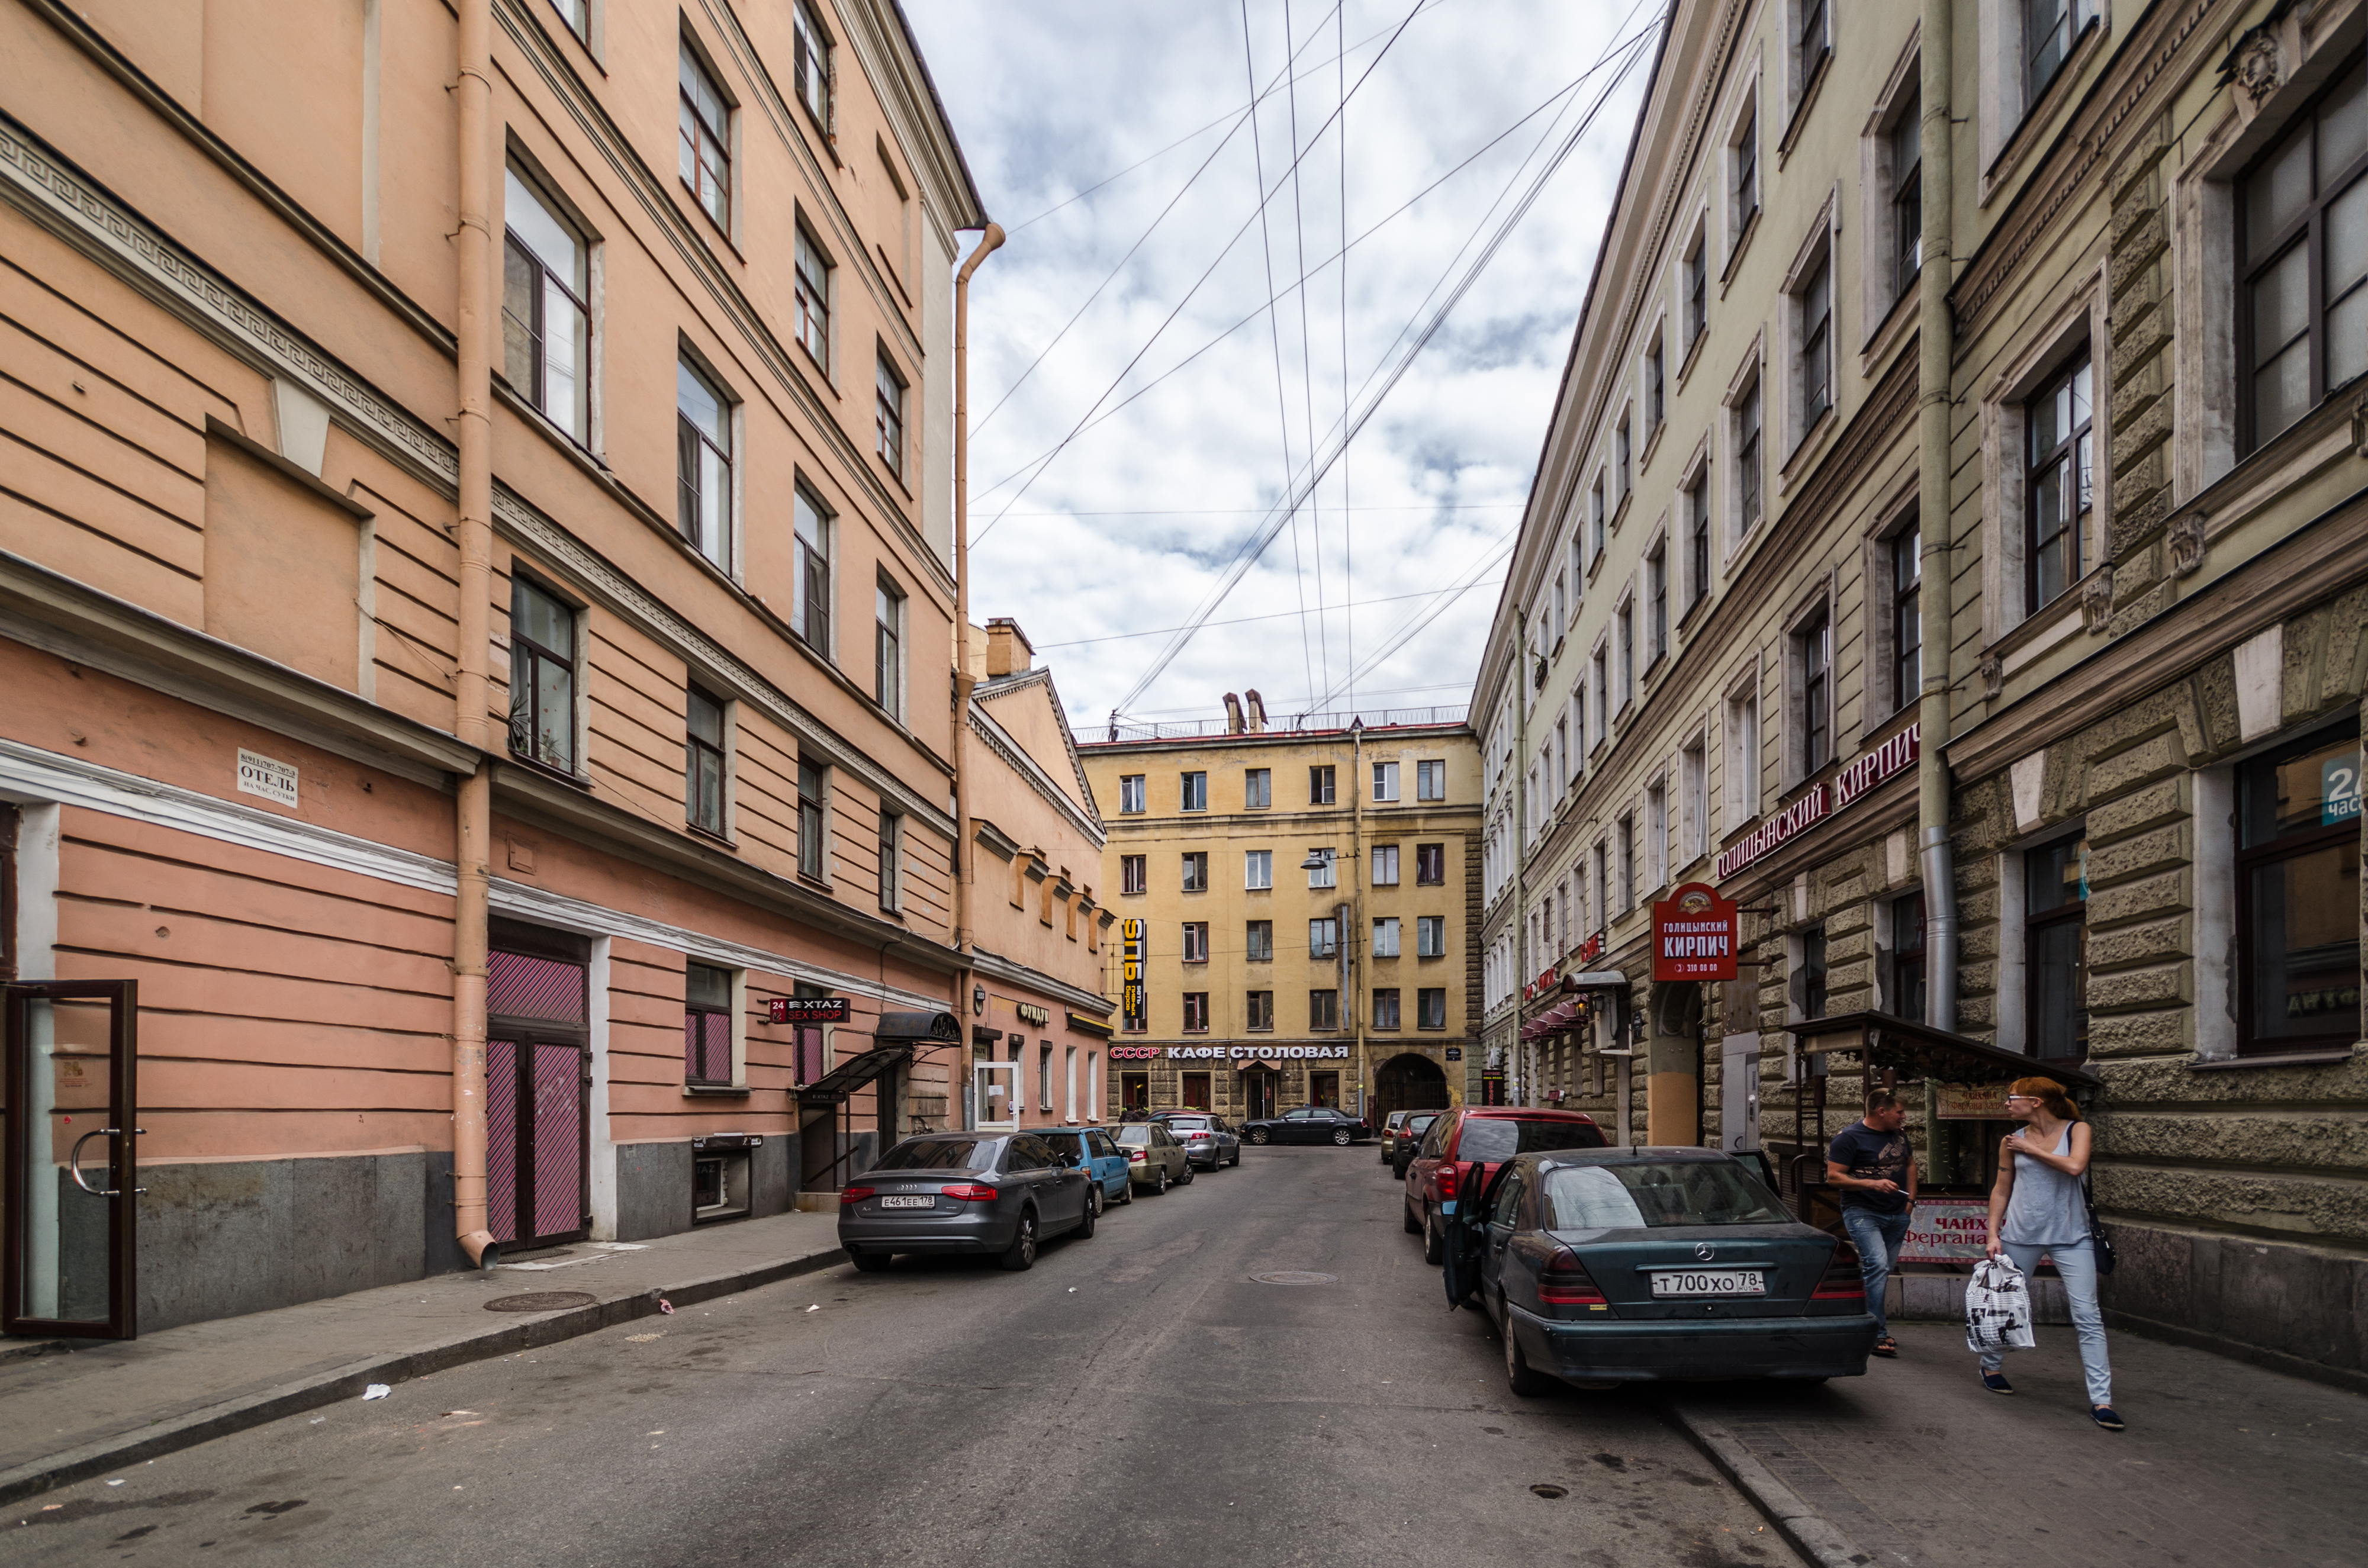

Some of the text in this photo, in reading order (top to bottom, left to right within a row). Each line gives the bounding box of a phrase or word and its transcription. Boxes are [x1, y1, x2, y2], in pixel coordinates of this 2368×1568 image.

[241, 754, 295, 776] 8(911)707-707-3
[242, 766, 294, 791] ОТЕЛЬ
[273, 790, 295, 801] СУТКИ
[1717, 783, 1823, 880] ГОЛИЦЫНСКИЙ
[1664, 920, 1728, 933] ГОЛИЦЫНСКИЙ
[1664, 936, 1728, 957] КИРПИЧ
[1710, 963, 1717, 971] 00
[788, 1010, 841, 1019] SEX SHOP
[1021, 1003, 1049, 1025] ФУНДУК
[1110, 1046, 1349, 1058] СССР КАФЕ СТОЛОВАЯ
[1952, 1102, 1982, 1112] Фергана
[1903, 1230, 1987, 1247] Фергана
[1659, 1273, 1757, 1291] Т700ХО 78
